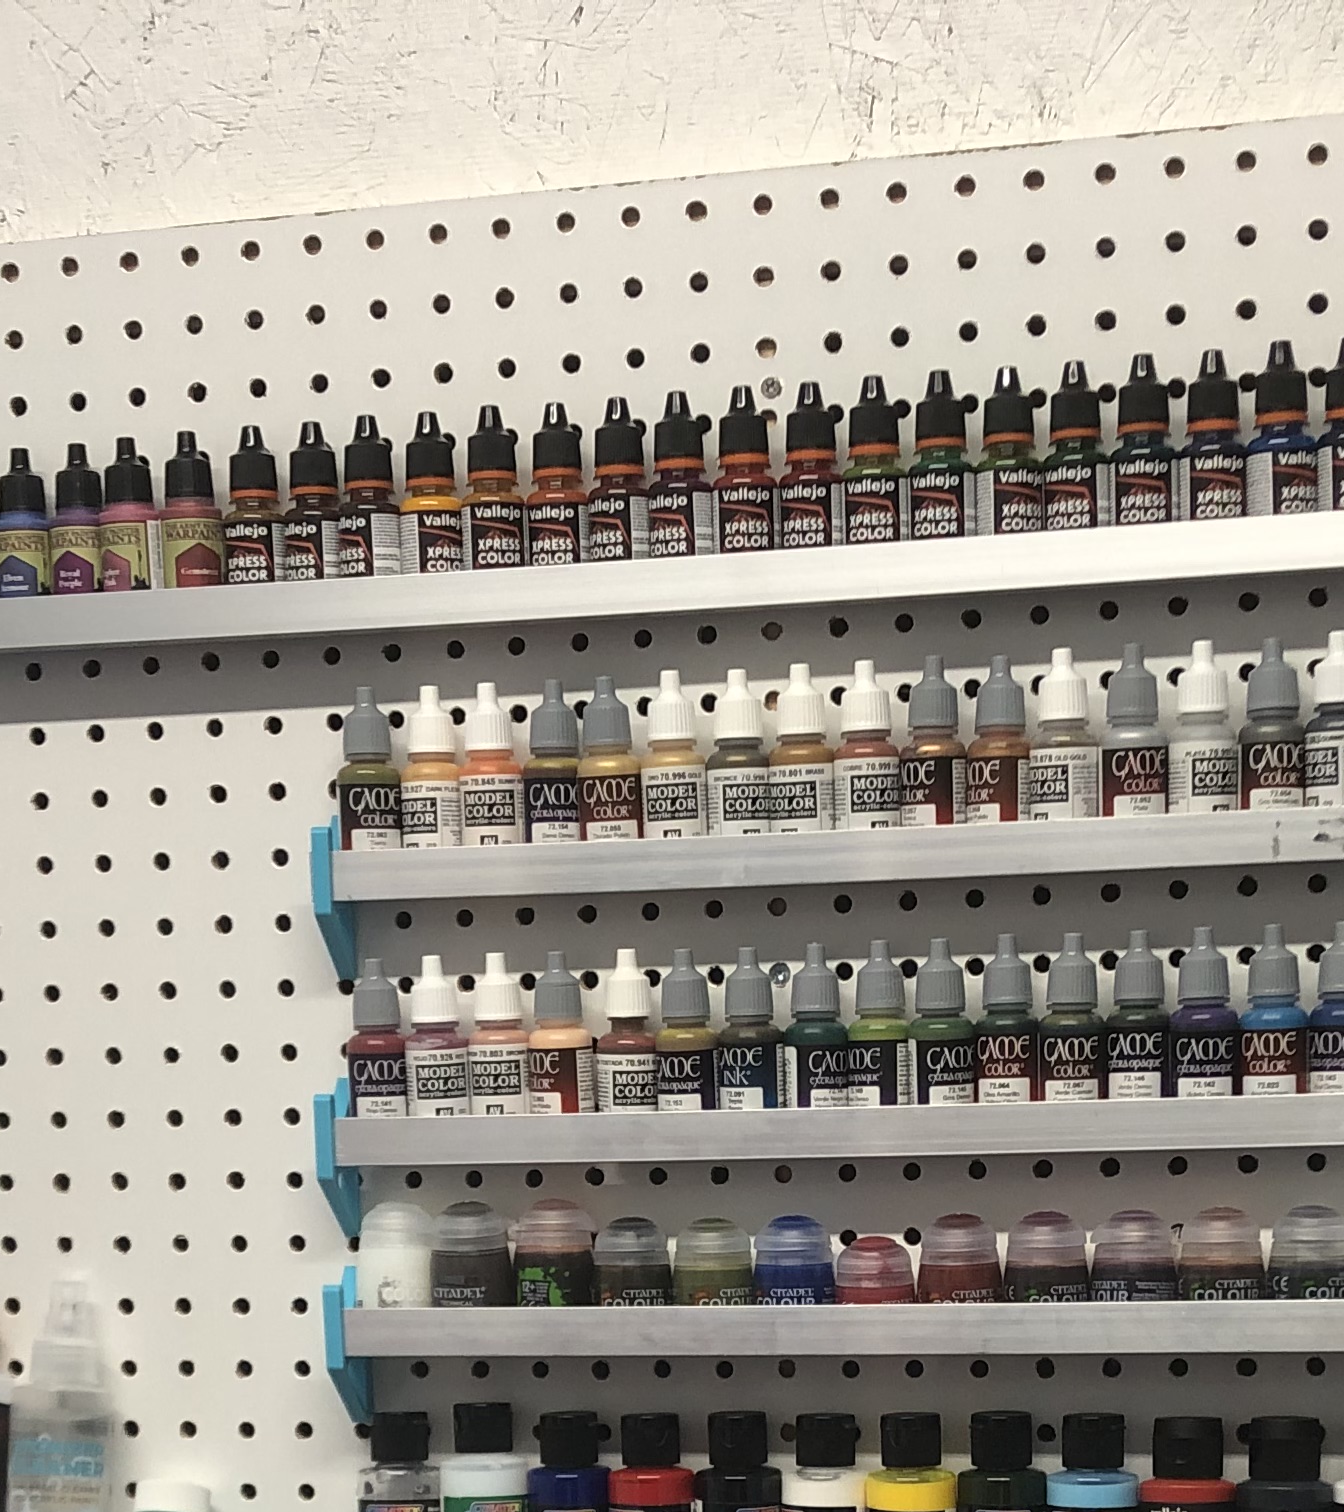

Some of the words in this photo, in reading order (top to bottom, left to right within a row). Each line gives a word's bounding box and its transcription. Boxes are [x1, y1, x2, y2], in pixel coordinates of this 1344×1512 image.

[1119, 459, 1168, 475] Vallejo
[1195, 456, 1243, 470] Vallejo
[913, 474, 959, 489] Vallejo
[1045, 467, 1091, 482] Vallejo
[782, 485, 826, 500] Vallejo
[848, 479, 895, 494] Vallejo
[723, 488, 770, 503] Vallejo
[1121, 494, 1166, 508] XPRESS
[1197, 490, 1242, 504] XPRESS
[475, 505, 521, 520] Vallejo
[529, 506, 574, 520] Vallejo
[915, 508, 957, 522] XPRESS
[1120, 508, 1166, 523] COLOR
[1197, 504, 1243, 518] COLOR
[726, 521, 768, 535] XPRESS
[784, 519, 824, 533] XPRESS
[850, 515, 894, 528] XPRESS
[915, 521, 958, 536] COLOR
[725, 534, 769, 548] COLOR
[784, 532, 824, 547] COLOR
[851, 527, 894, 542] COLOR
[478, 538, 521, 552] XPRESS
[532, 539, 573, 552] XPRESS
[478, 551, 521, 565] COLOR
[533, 552, 574, 566] COLOR
[1112, 751, 1164, 780] GAME
[1249, 744, 1305, 773] GAME
[583, 778, 636, 804] GAME
[648, 784, 696, 799] MODEL
[466, 792, 514, 805] MODEL
[466, 806, 514, 818] COLOR
[1044, 1036, 1099, 1063] GAME
[1108, 1031, 1162, 1059] GAME
[1177, 1037, 1233, 1064] GAME
[1242, 1031, 1297, 1060] GAME
[418, 1066, 465, 1078] MODEL
[473, 1062, 519, 1075] MODEL
[418, 1078, 466, 1091] COLOR
[474, 1075, 519, 1087] COLOR
[1216, 1279, 1258, 1288] CITADEL
[434, 1287, 482, 1297] CITADEL
[623, 1289, 663, 1297] CITADEL
[771, 1288, 814, 1297] CITADEL
[952, 1289, 993, 1298] CITADEL
[1194, 1289, 1258, 1300] COLOUR
